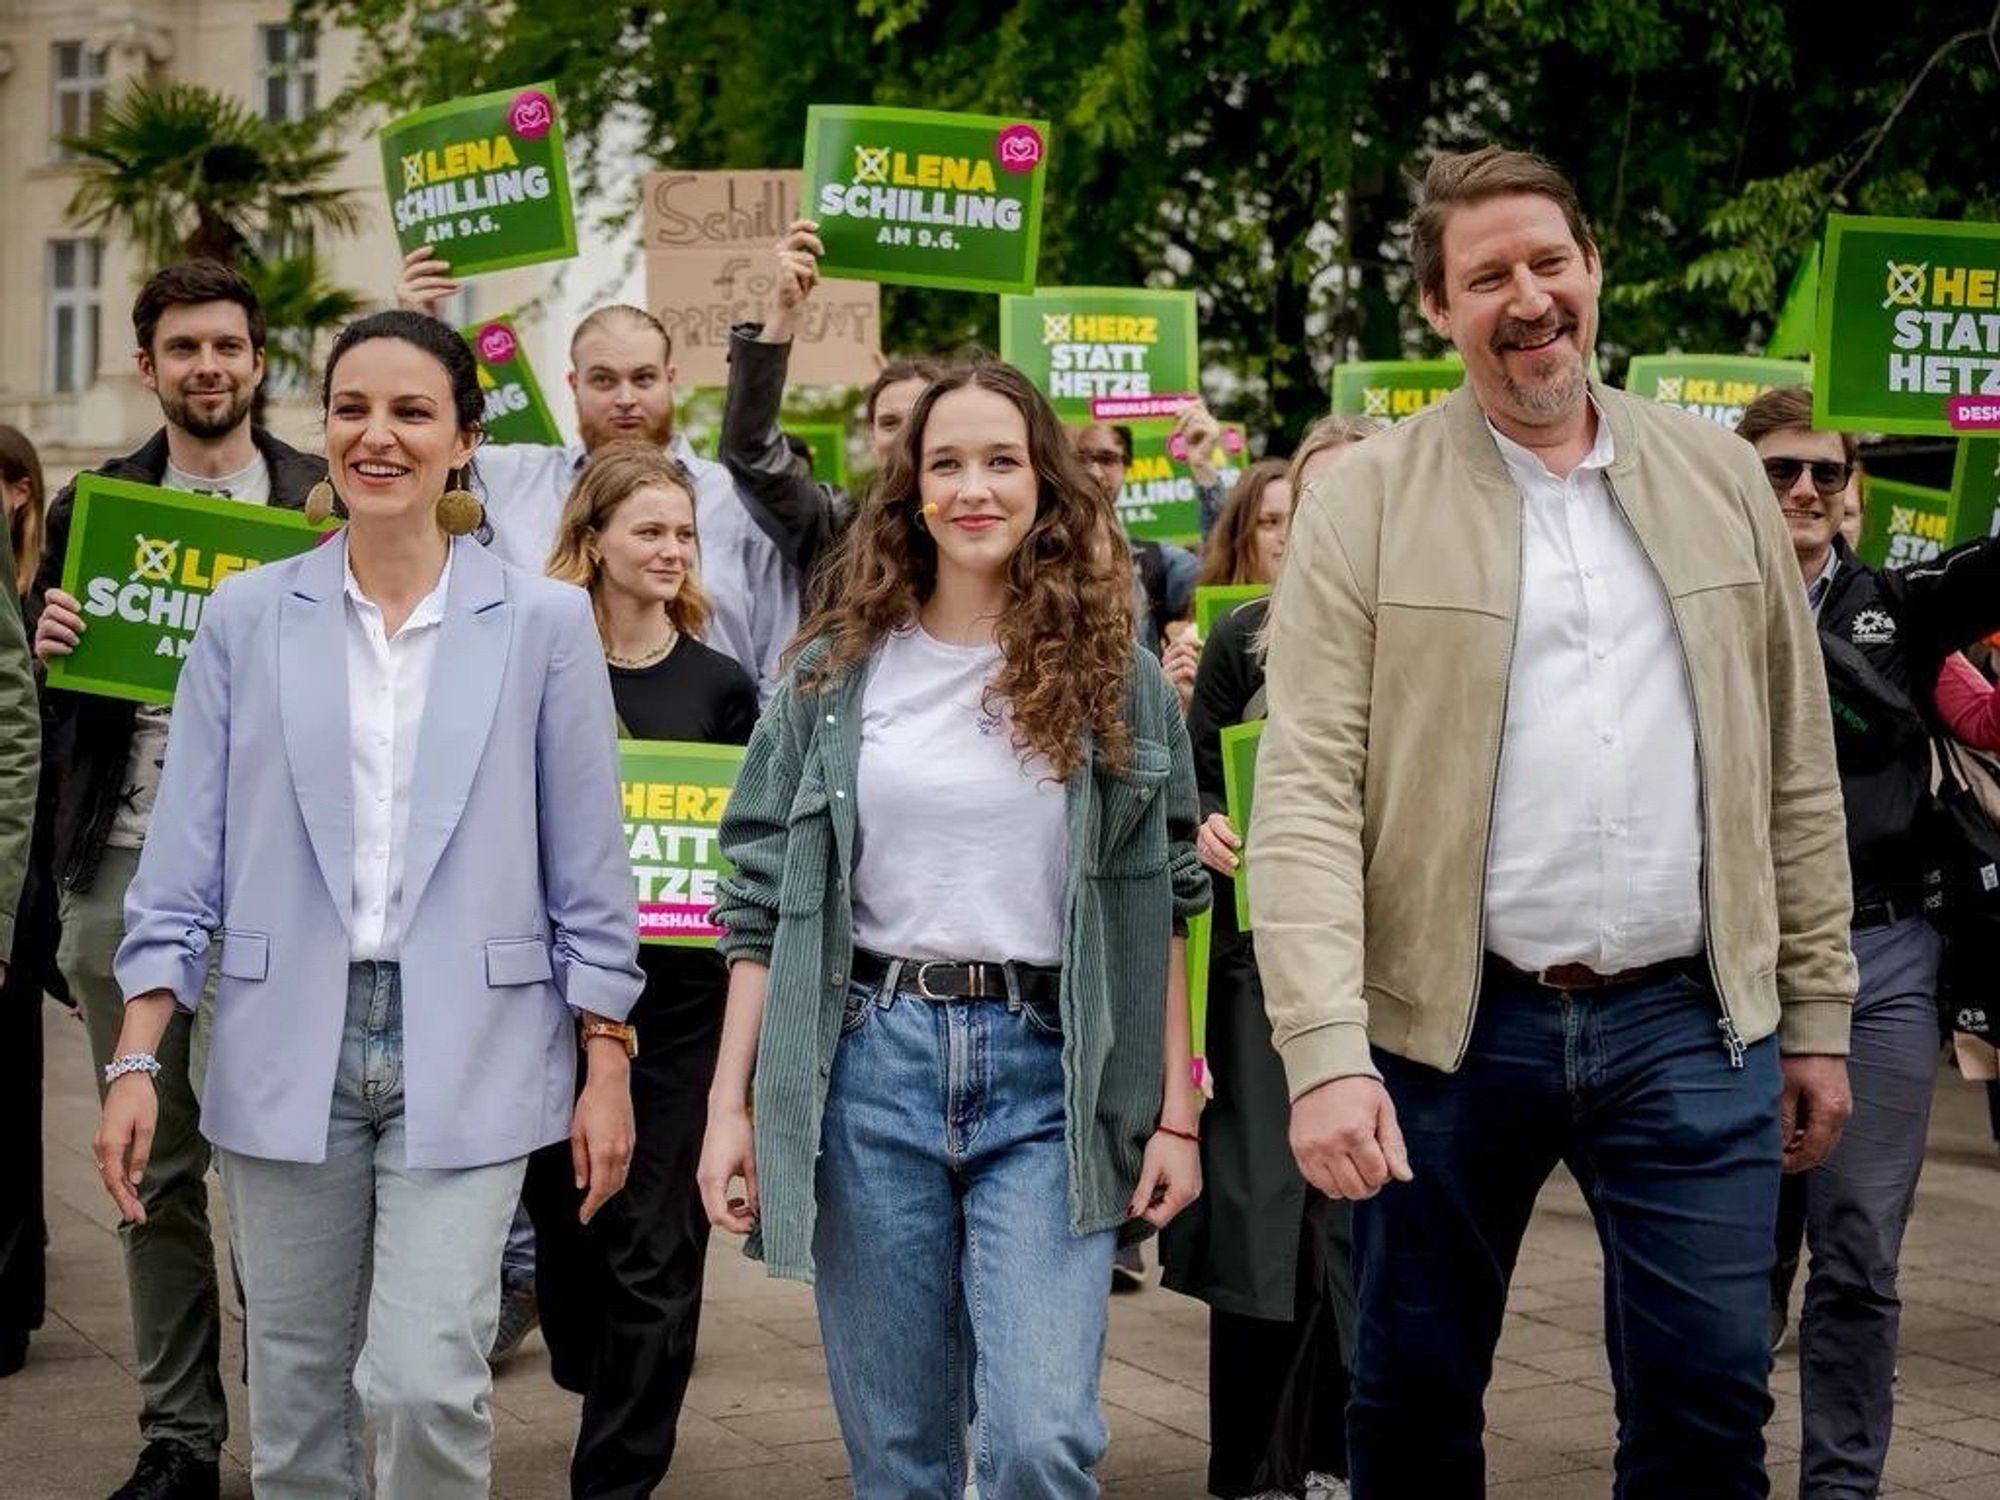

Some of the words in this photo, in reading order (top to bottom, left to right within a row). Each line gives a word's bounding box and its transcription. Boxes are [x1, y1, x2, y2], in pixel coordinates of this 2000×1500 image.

[426, 135, 519, 182] LENA
[892, 152, 996, 192] LENA
[395, 166, 550, 231] SCHILLING
[820, 183, 1022, 231] SCHILLING
[424, 222, 454, 243] AM
[458, 214, 501, 236] 9.6.
[877, 226, 911, 246] AM
[918, 229, 960, 250] 9.6.
[713, 258, 777, 300] fo
[1932, 267, 2000, 308] HE
[1074, 314, 1157, 343] HERZ
[1051, 344, 1148, 371] STATT
[1049, 371, 1151, 398] HETZE
[1890, 534, 1945, 562] STA
[181, 548, 260, 590] LE
[84, 576, 205, 631] SCHI
[621, 781, 733, 822] HERZ
